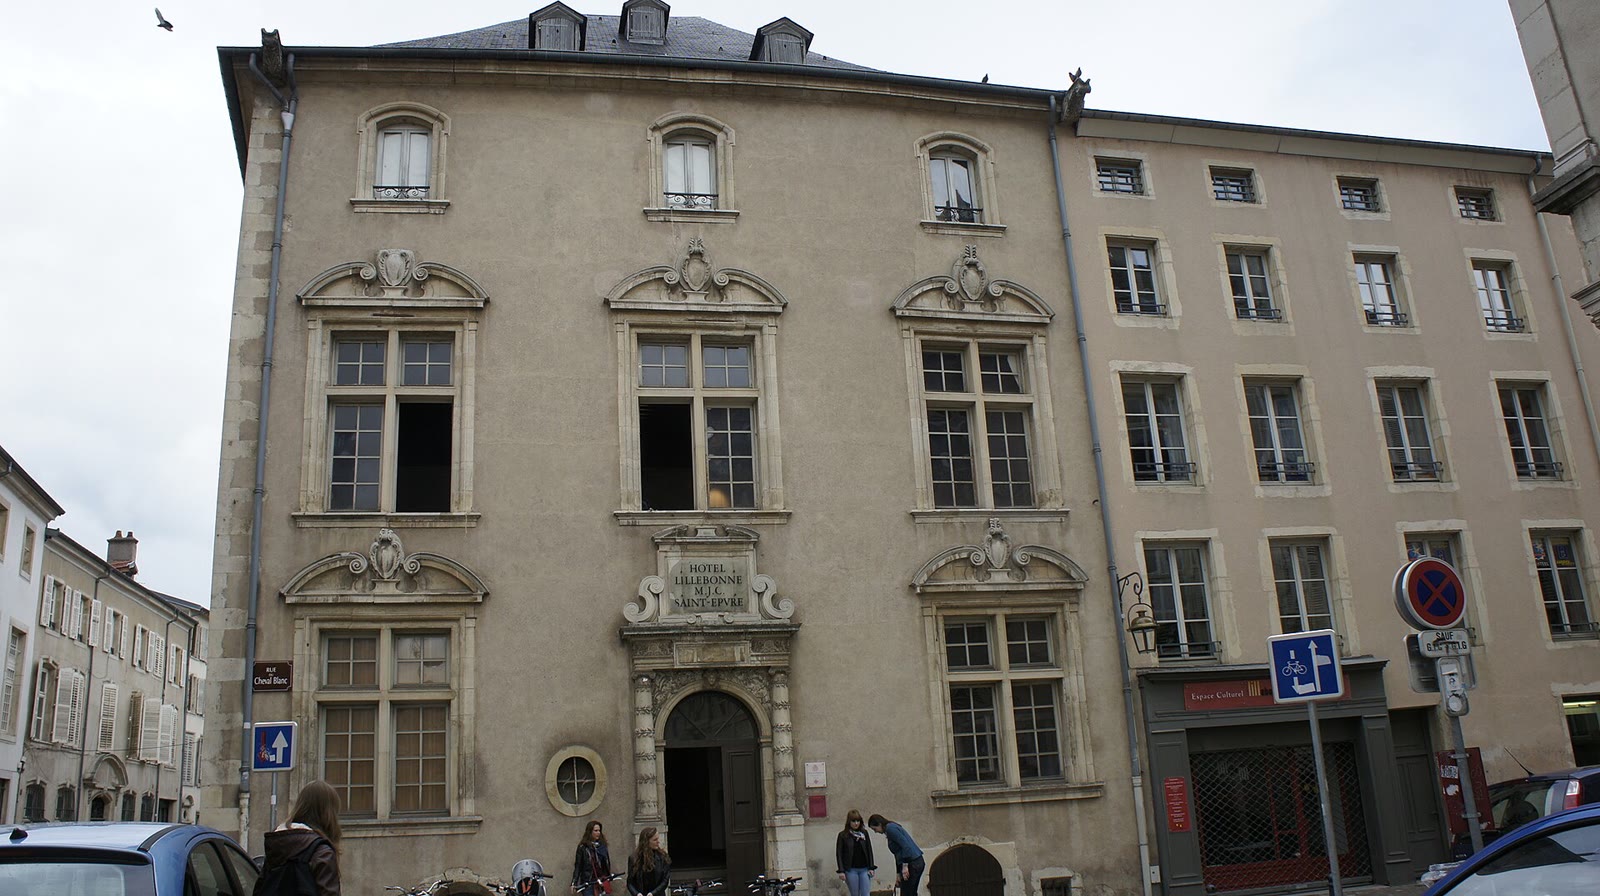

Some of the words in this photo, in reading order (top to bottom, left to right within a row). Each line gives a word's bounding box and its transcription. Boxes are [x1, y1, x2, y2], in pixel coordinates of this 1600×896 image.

[689, 564, 726, 573] HOTEL
[675, 575, 743, 585] LILLEBONNE
[694, 586, 725, 598] M.J.C.
[674, 597, 744, 607] SAINT-EPVRE
[1435, 632, 1454, 640] SAUF
[254, 676, 272, 685] Cheval
[1191, 692, 1214, 701] Espace
[1216, 690, 1244, 699] Culturel
